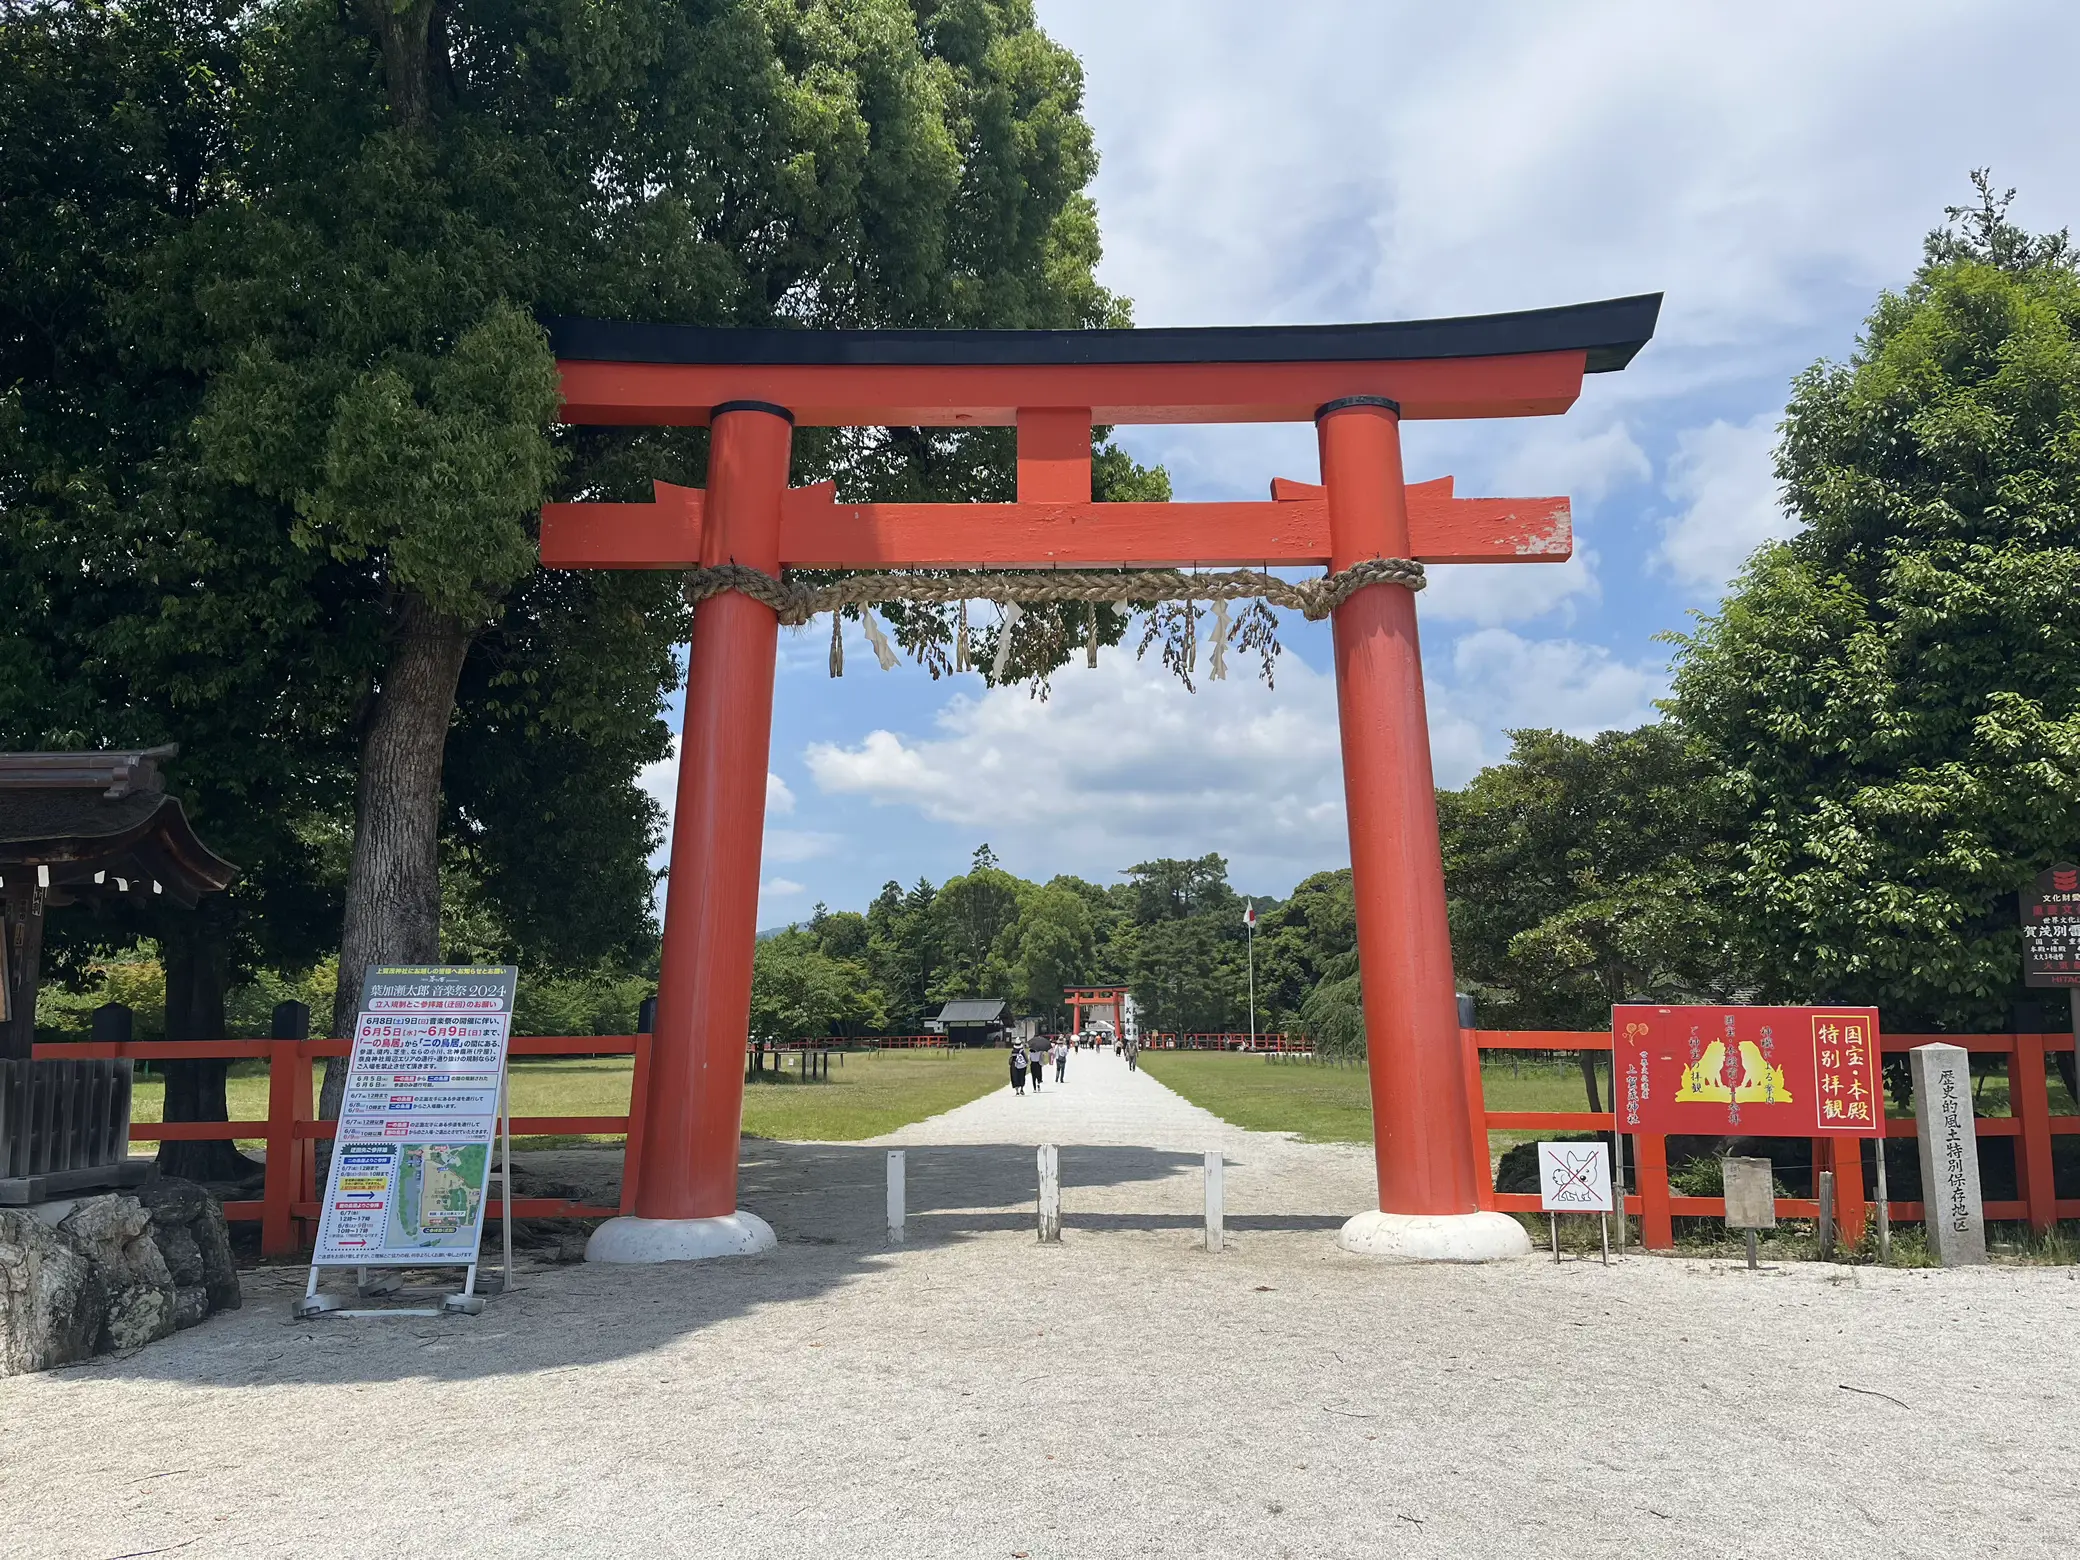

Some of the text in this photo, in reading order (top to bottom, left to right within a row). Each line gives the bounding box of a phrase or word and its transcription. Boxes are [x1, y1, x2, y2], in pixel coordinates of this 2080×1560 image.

[432, 984, 466, 997] 音楽祭
[468, 984, 506, 996] 2024
[1818, 1024, 1847, 1120] 特別拝観
[1844, 1025, 1870, 1120] 国宝・本殿
[1938, 1070, 1970, 1232] 歴史的風土特別保存地区
